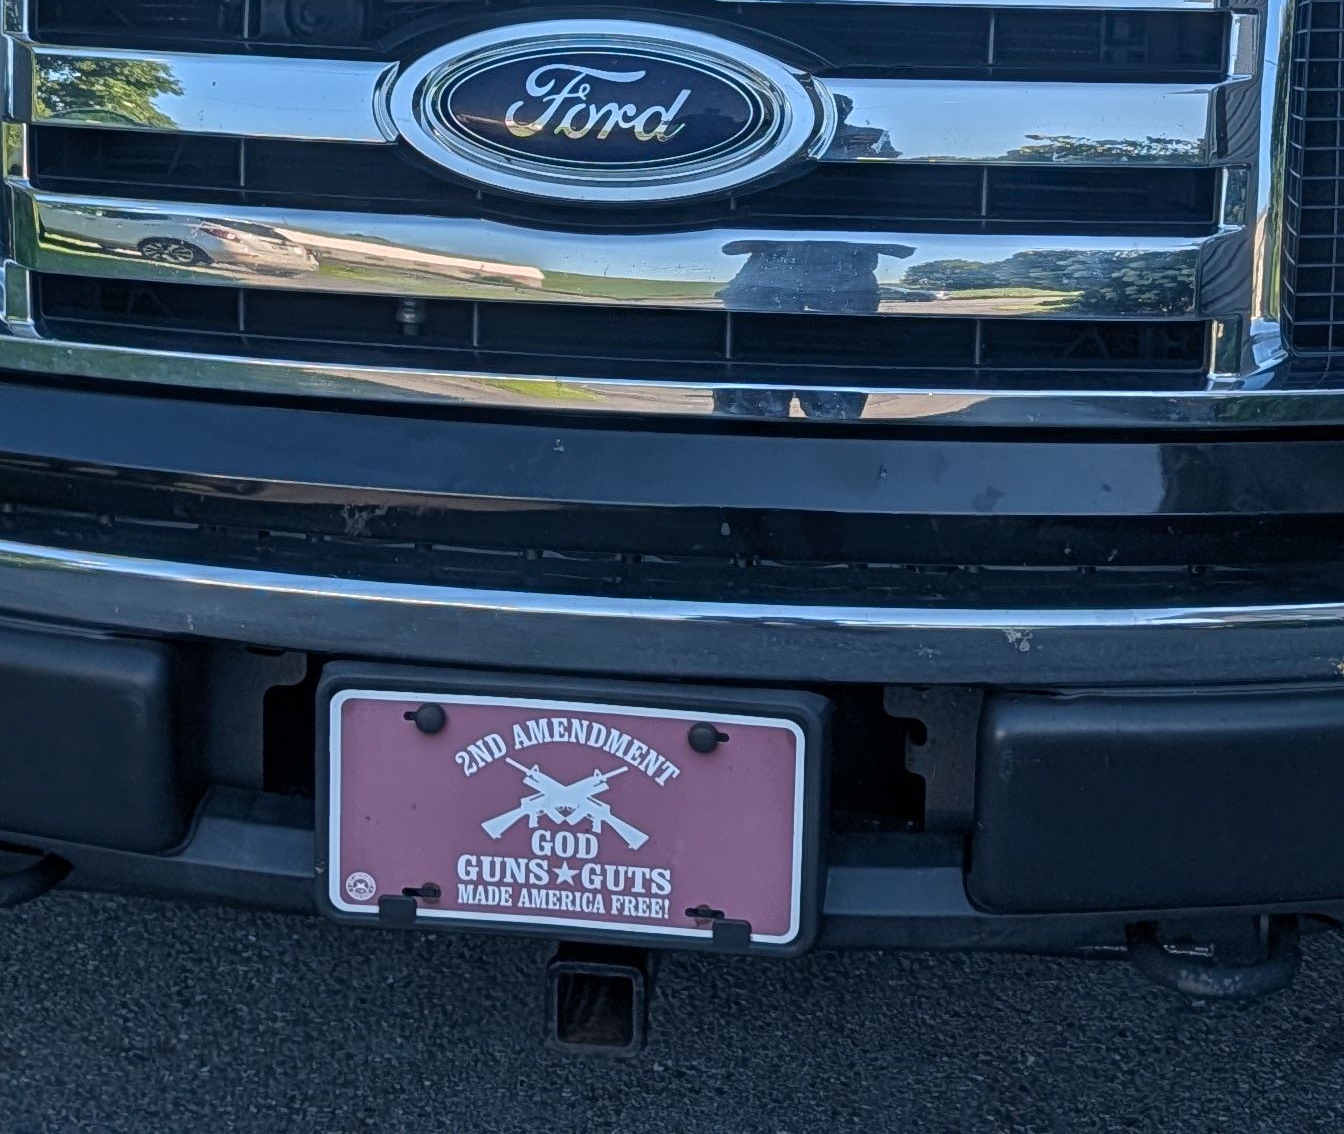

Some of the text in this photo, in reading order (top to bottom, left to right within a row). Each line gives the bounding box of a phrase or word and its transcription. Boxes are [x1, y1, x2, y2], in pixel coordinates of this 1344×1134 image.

[504, 64, 692, 142] Ford
[455, 717, 681, 787] 2ND AMENDMENT
[531, 830, 599, 859] GOD
[457, 854, 672, 895] GUNS GUTS
[457, 883, 670, 919] MADE AMERICA FREE!
